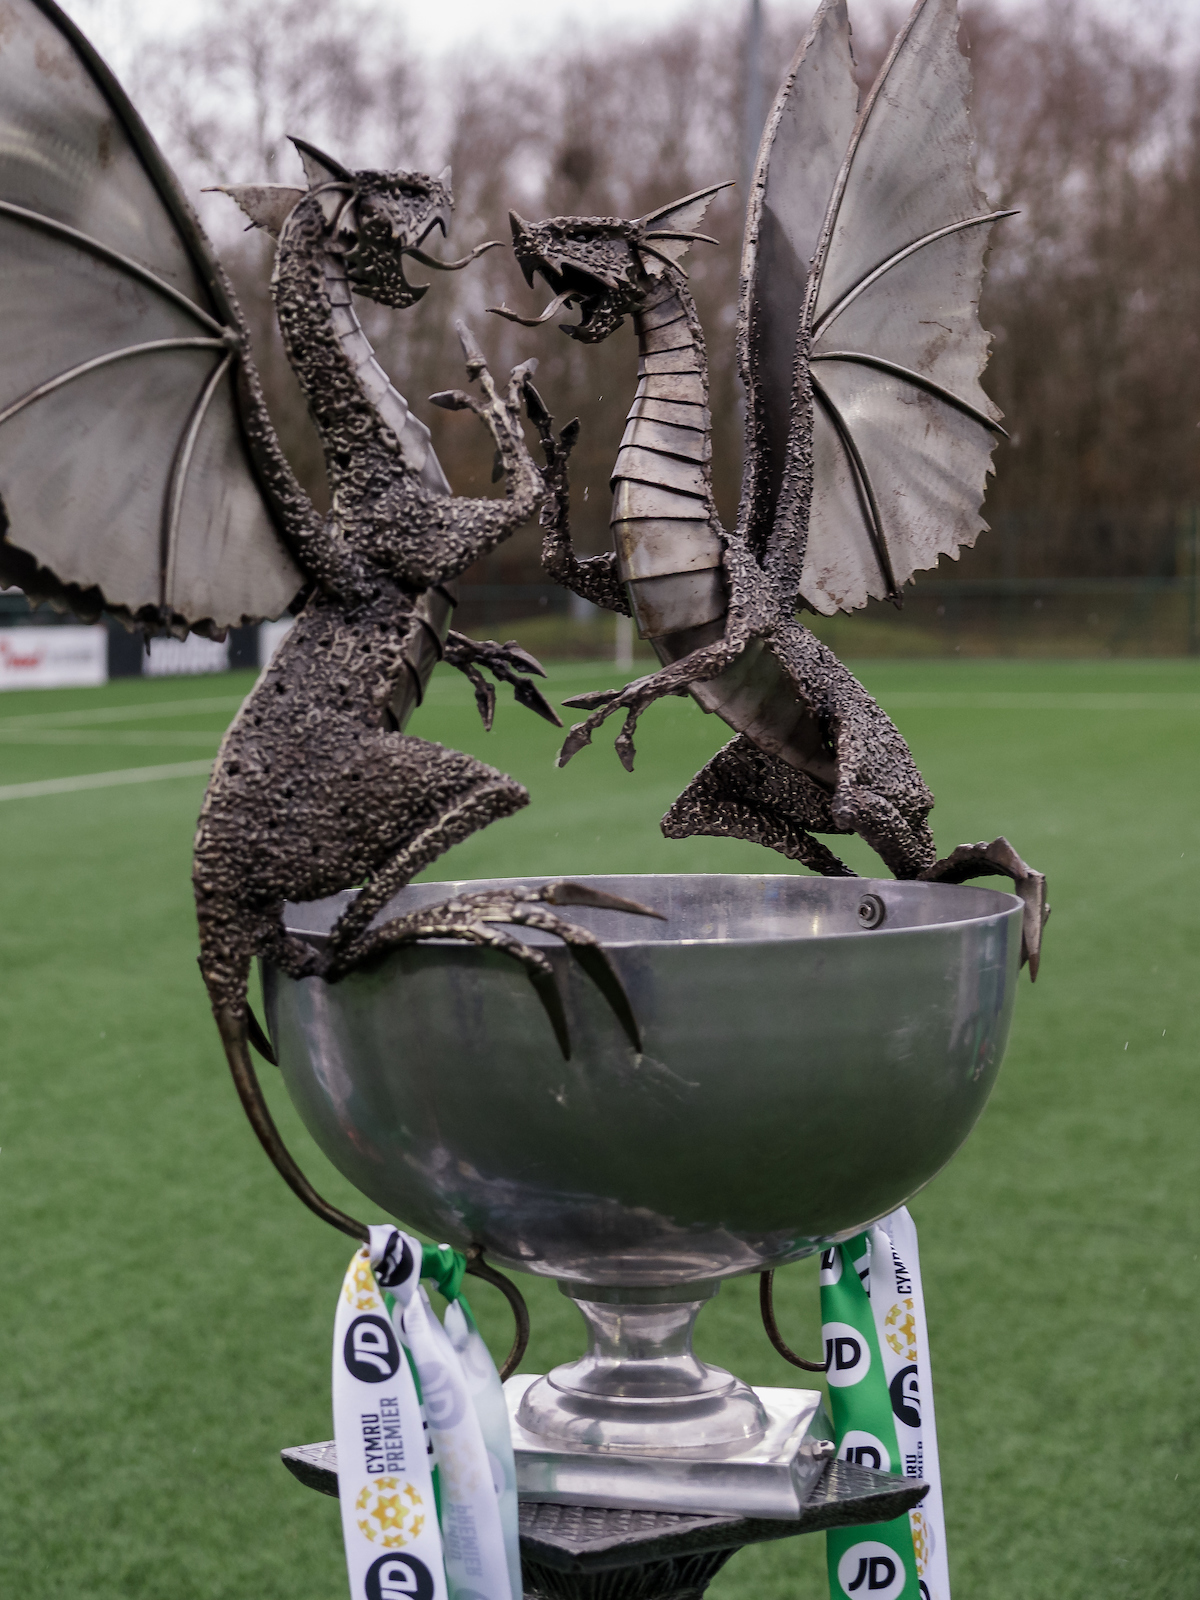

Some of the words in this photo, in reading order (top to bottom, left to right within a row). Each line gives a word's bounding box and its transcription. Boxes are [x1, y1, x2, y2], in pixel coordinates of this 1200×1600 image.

[353, 1321, 392, 1376] JD
[362, 1413, 386, 1474] CYMRU
[380, 1397, 406, 1473] PREMIER
[848, 1556, 896, 1592] JD
